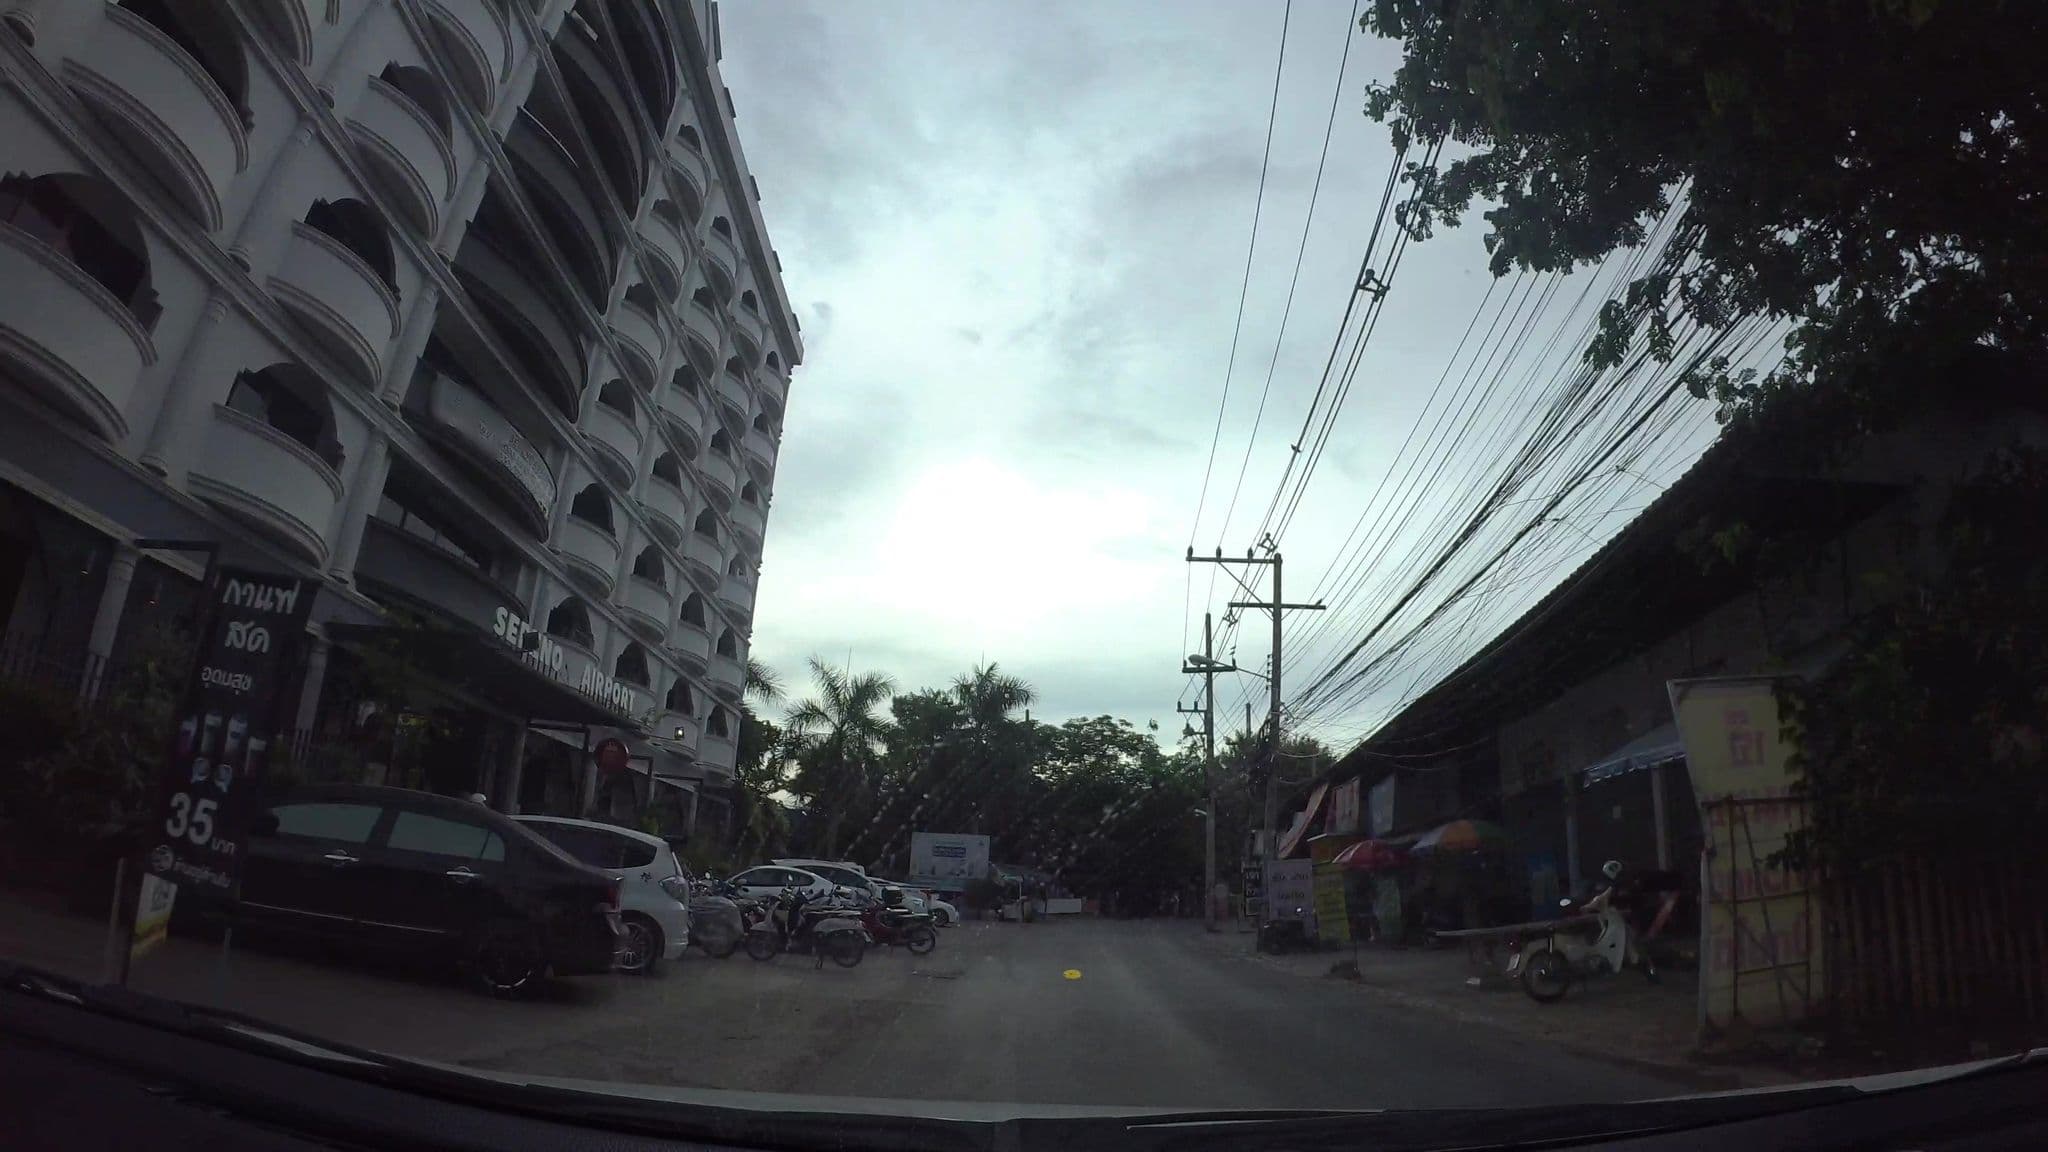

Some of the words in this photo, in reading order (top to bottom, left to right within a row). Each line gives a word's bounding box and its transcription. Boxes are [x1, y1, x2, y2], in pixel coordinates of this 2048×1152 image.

[224, 620, 270, 654] สด
[493, 606, 563, 672] SENO
[579, 663, 636, 712] AIRPORT
[166, 792, 218, 846] 35
